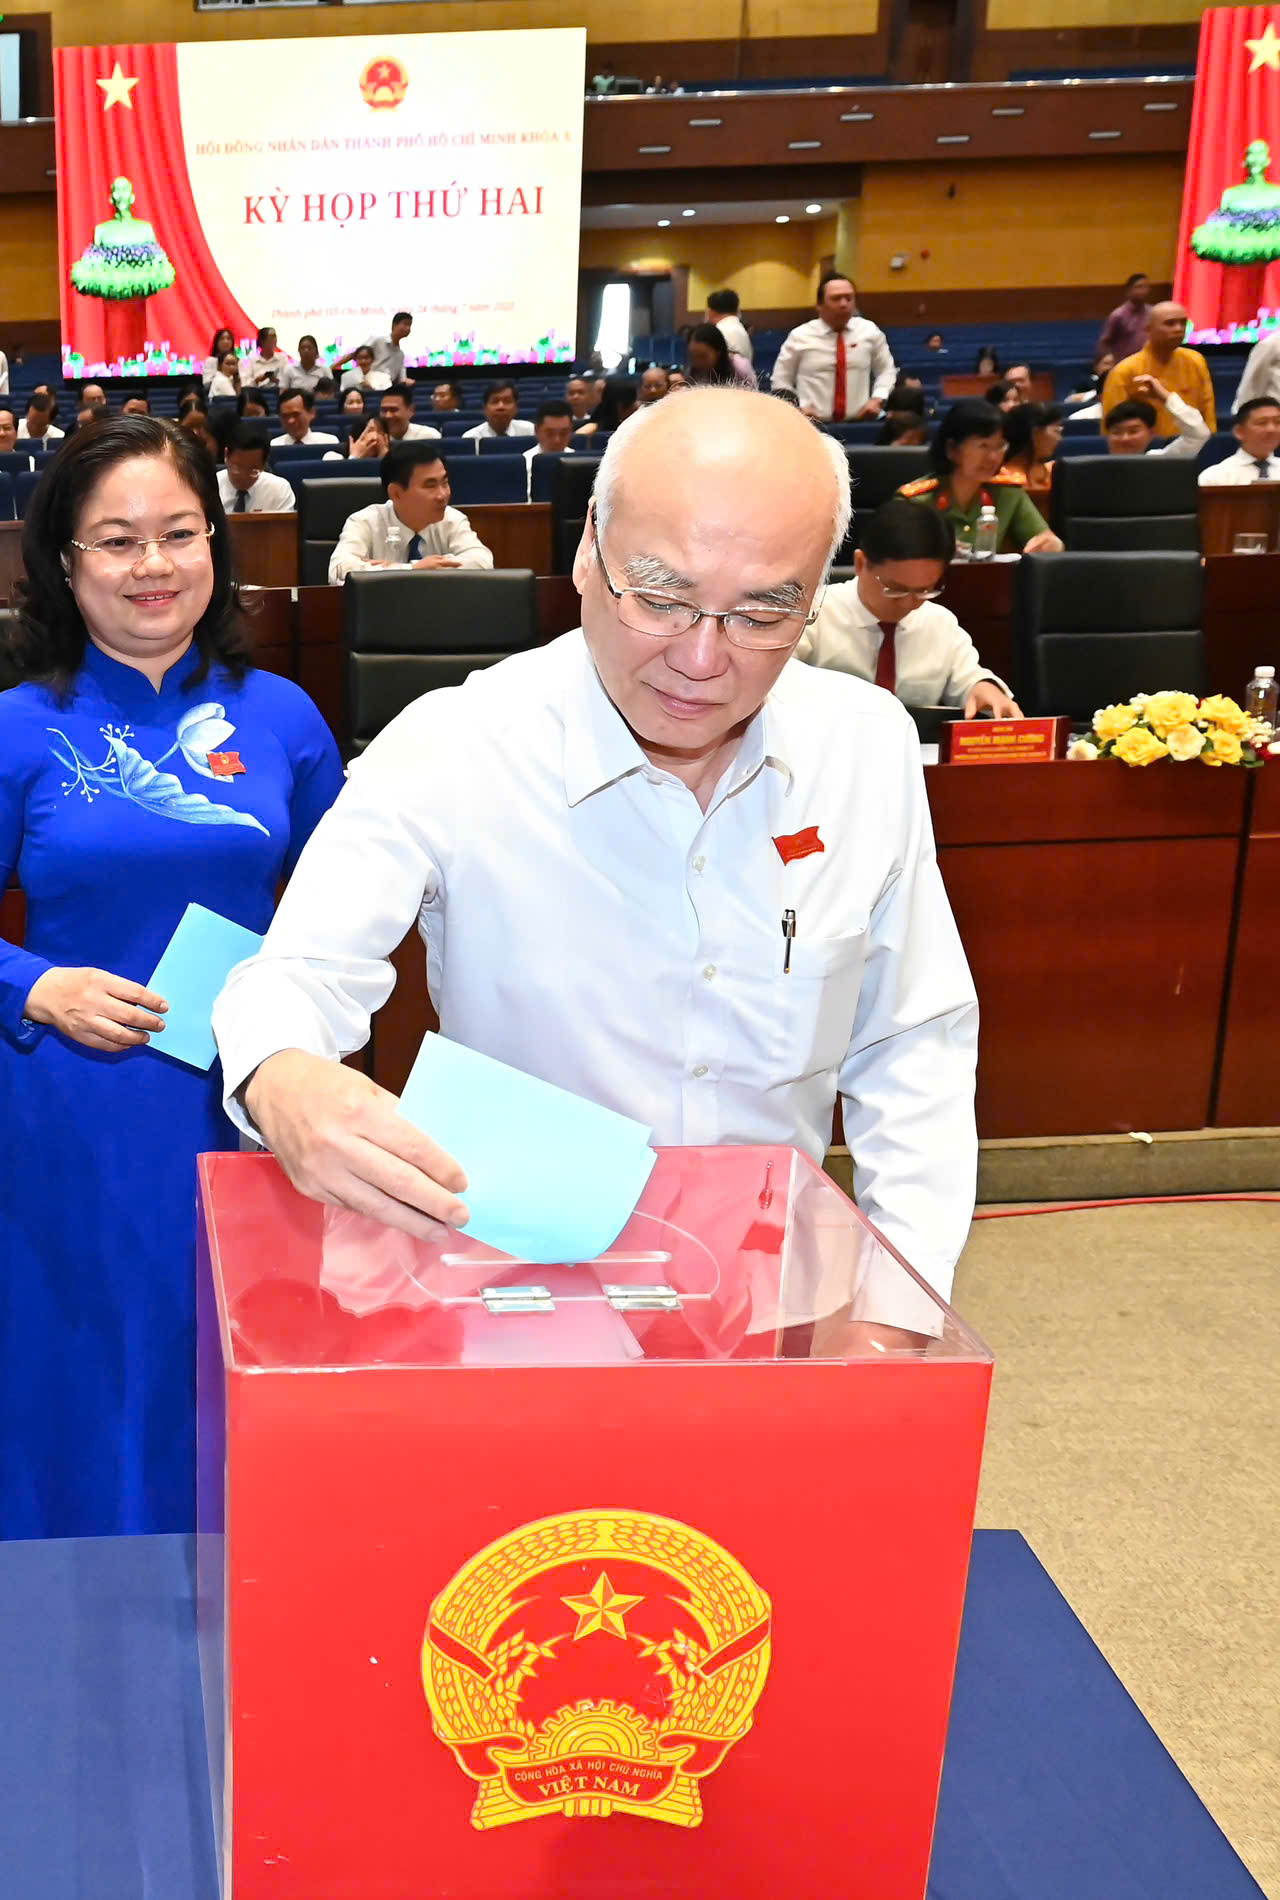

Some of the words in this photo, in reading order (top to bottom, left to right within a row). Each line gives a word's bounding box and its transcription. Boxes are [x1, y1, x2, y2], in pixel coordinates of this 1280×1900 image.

[480, 132, 516, 145] MINH
[243, 186, 290, 225] KỲ
[303, 191, 377, 229] HỌP
[388, 180, 469, 219] THỨ
[480, 185, 544, 217] HAI
[538, 1774, 588, 1797] VIỆT
[593, 1776, 641, 1798] NAM
